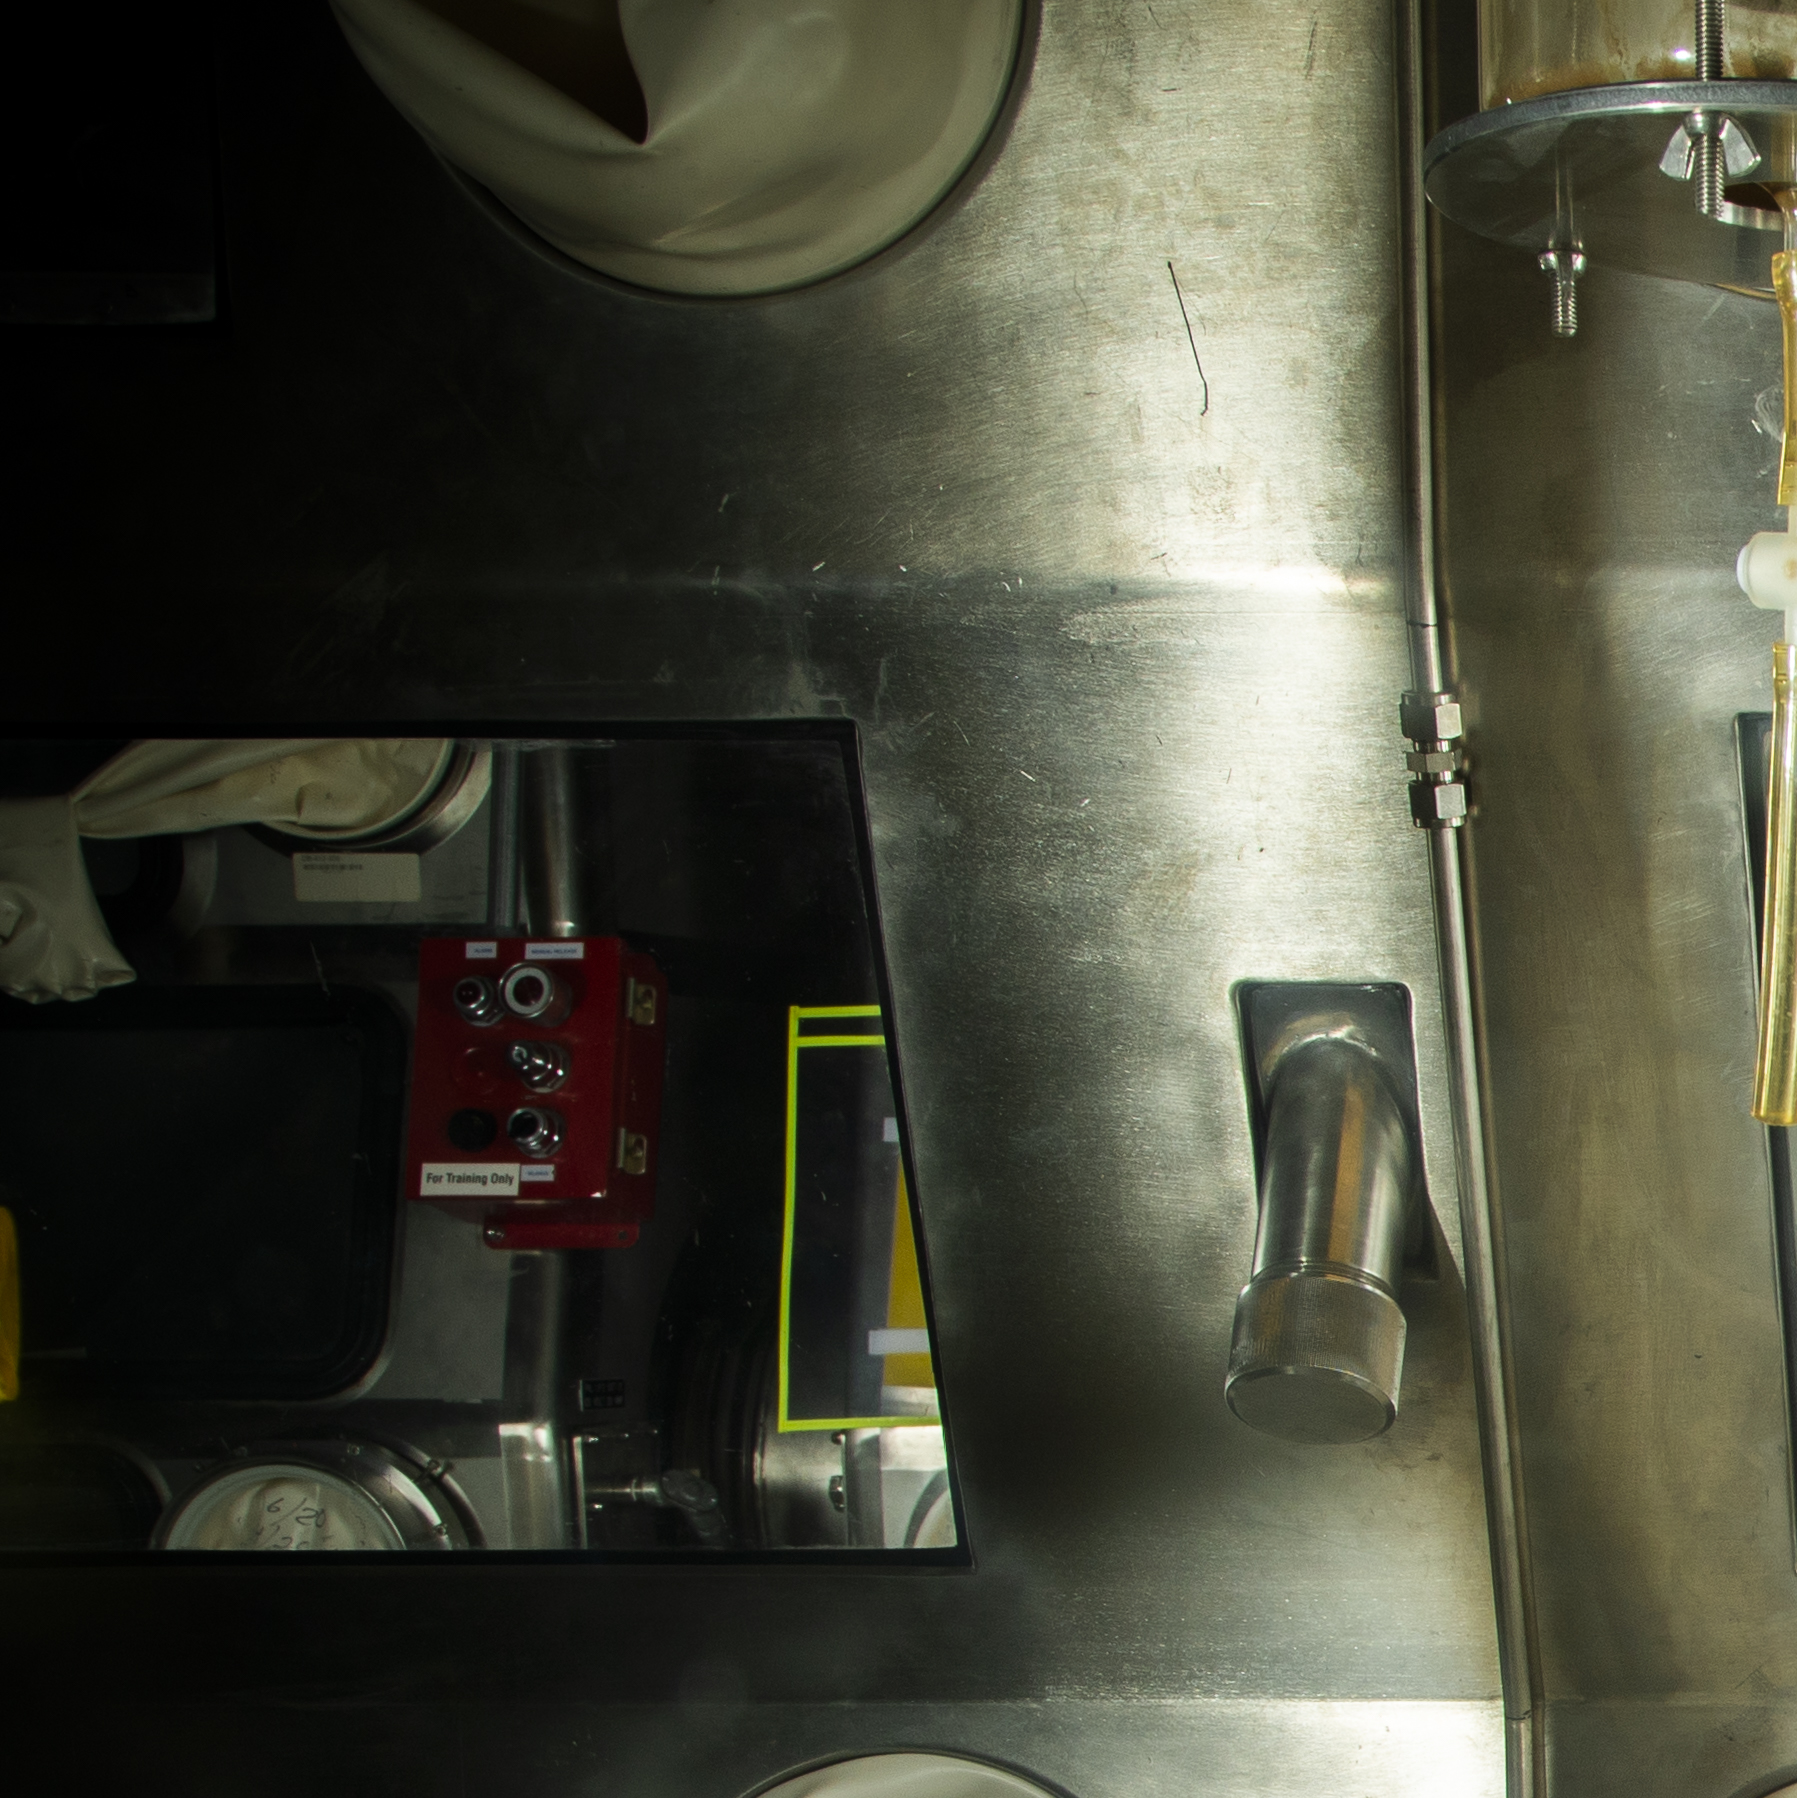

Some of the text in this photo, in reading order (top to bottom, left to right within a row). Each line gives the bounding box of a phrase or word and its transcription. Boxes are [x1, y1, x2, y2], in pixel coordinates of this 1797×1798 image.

[426, 1172, 515, 1187] For Training Only
